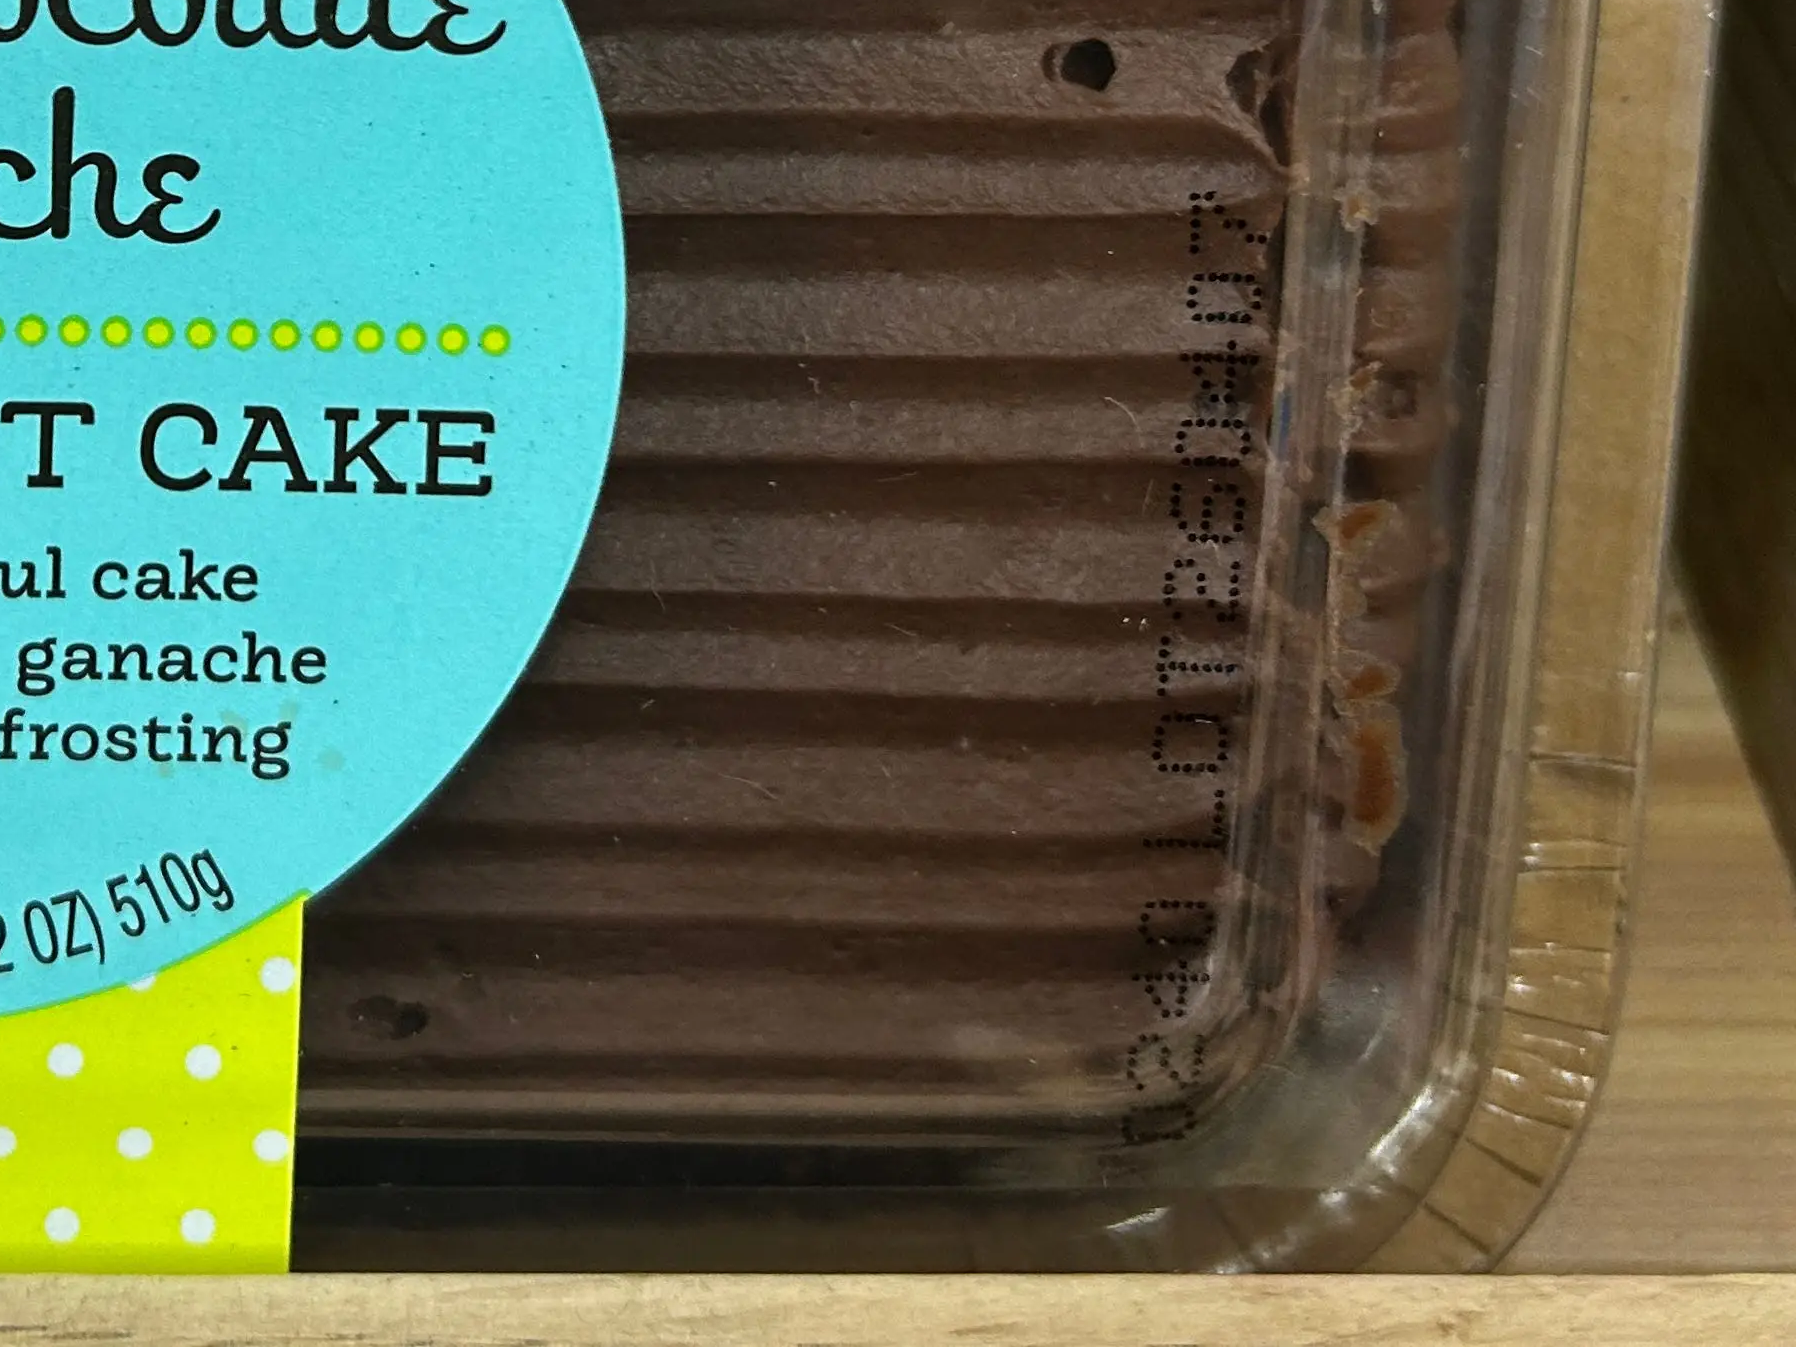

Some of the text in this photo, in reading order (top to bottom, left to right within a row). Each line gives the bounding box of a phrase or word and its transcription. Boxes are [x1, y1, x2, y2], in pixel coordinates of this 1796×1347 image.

[141, 403, 494, 496] CAKE
[93, 549, 257, 602] cake
[18, 632, 326, 696] ganache
[23, 888, 106, 965] OZ)
[105, 847, 235, 938] 510g
